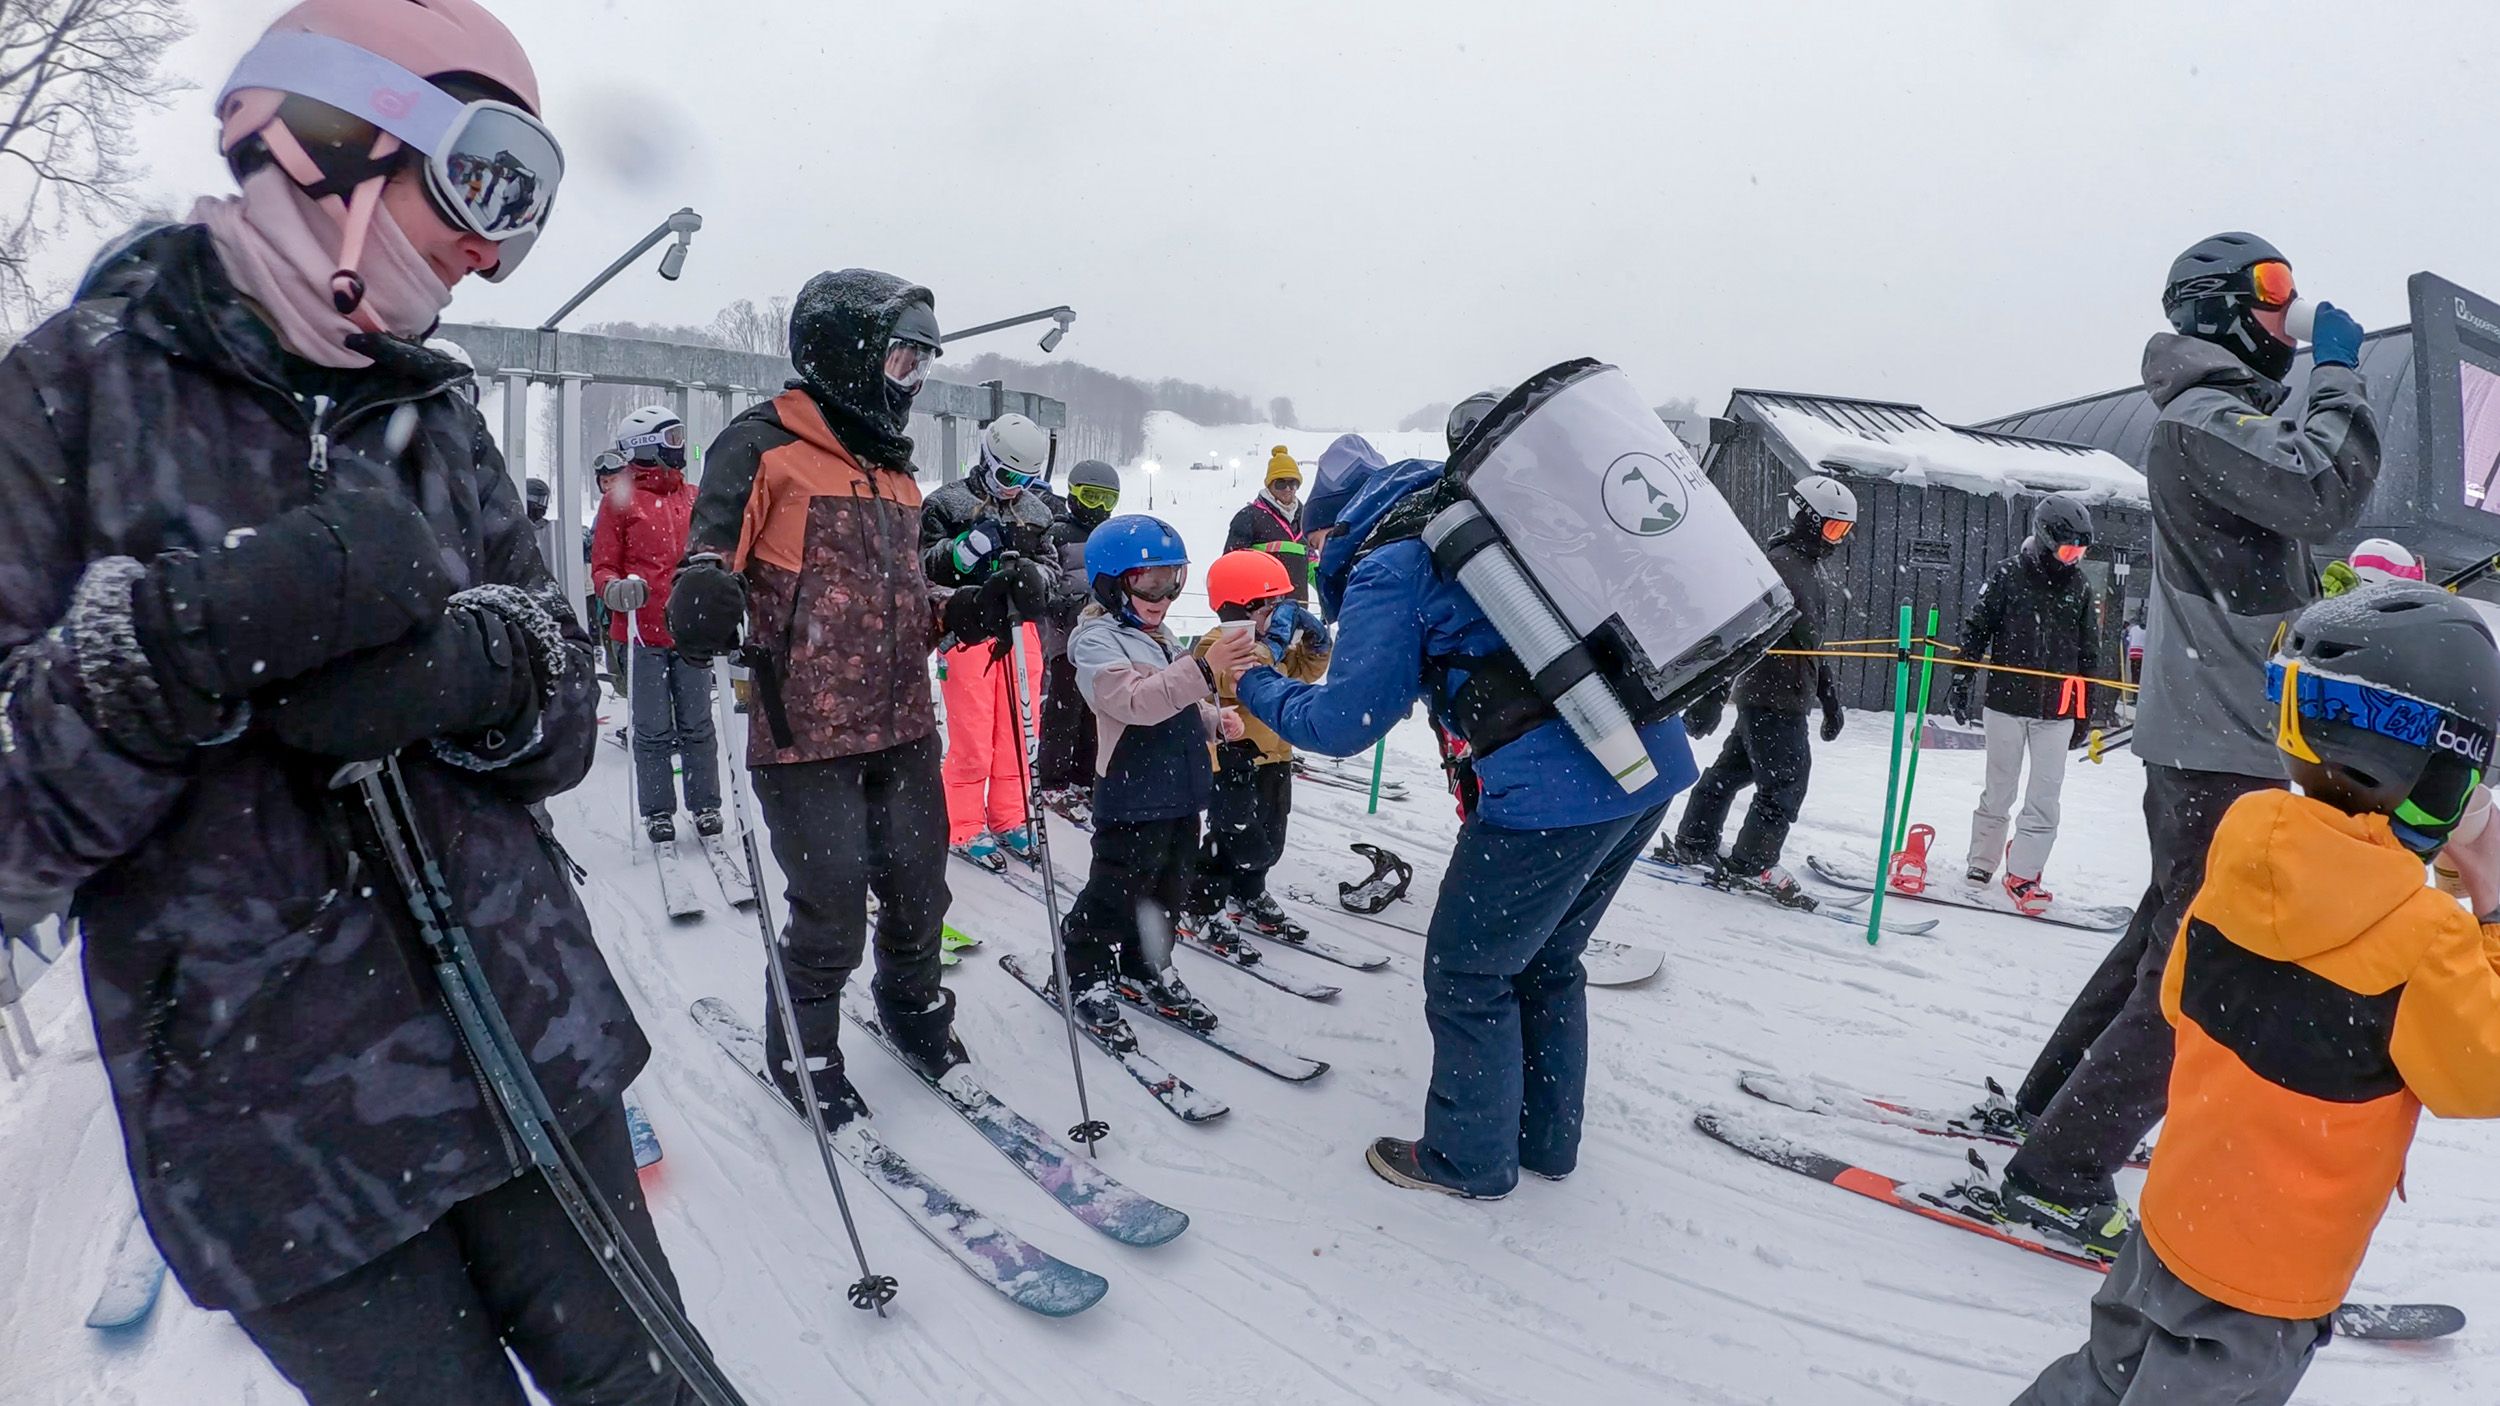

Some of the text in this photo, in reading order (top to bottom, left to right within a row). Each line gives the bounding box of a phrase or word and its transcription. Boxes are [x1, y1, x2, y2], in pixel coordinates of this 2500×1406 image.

[630, 435, 656, 446] GIRO
[1794, 495, 1820, 522] GIRO
[2016, 1195, 2080, 1229] NORDICA
